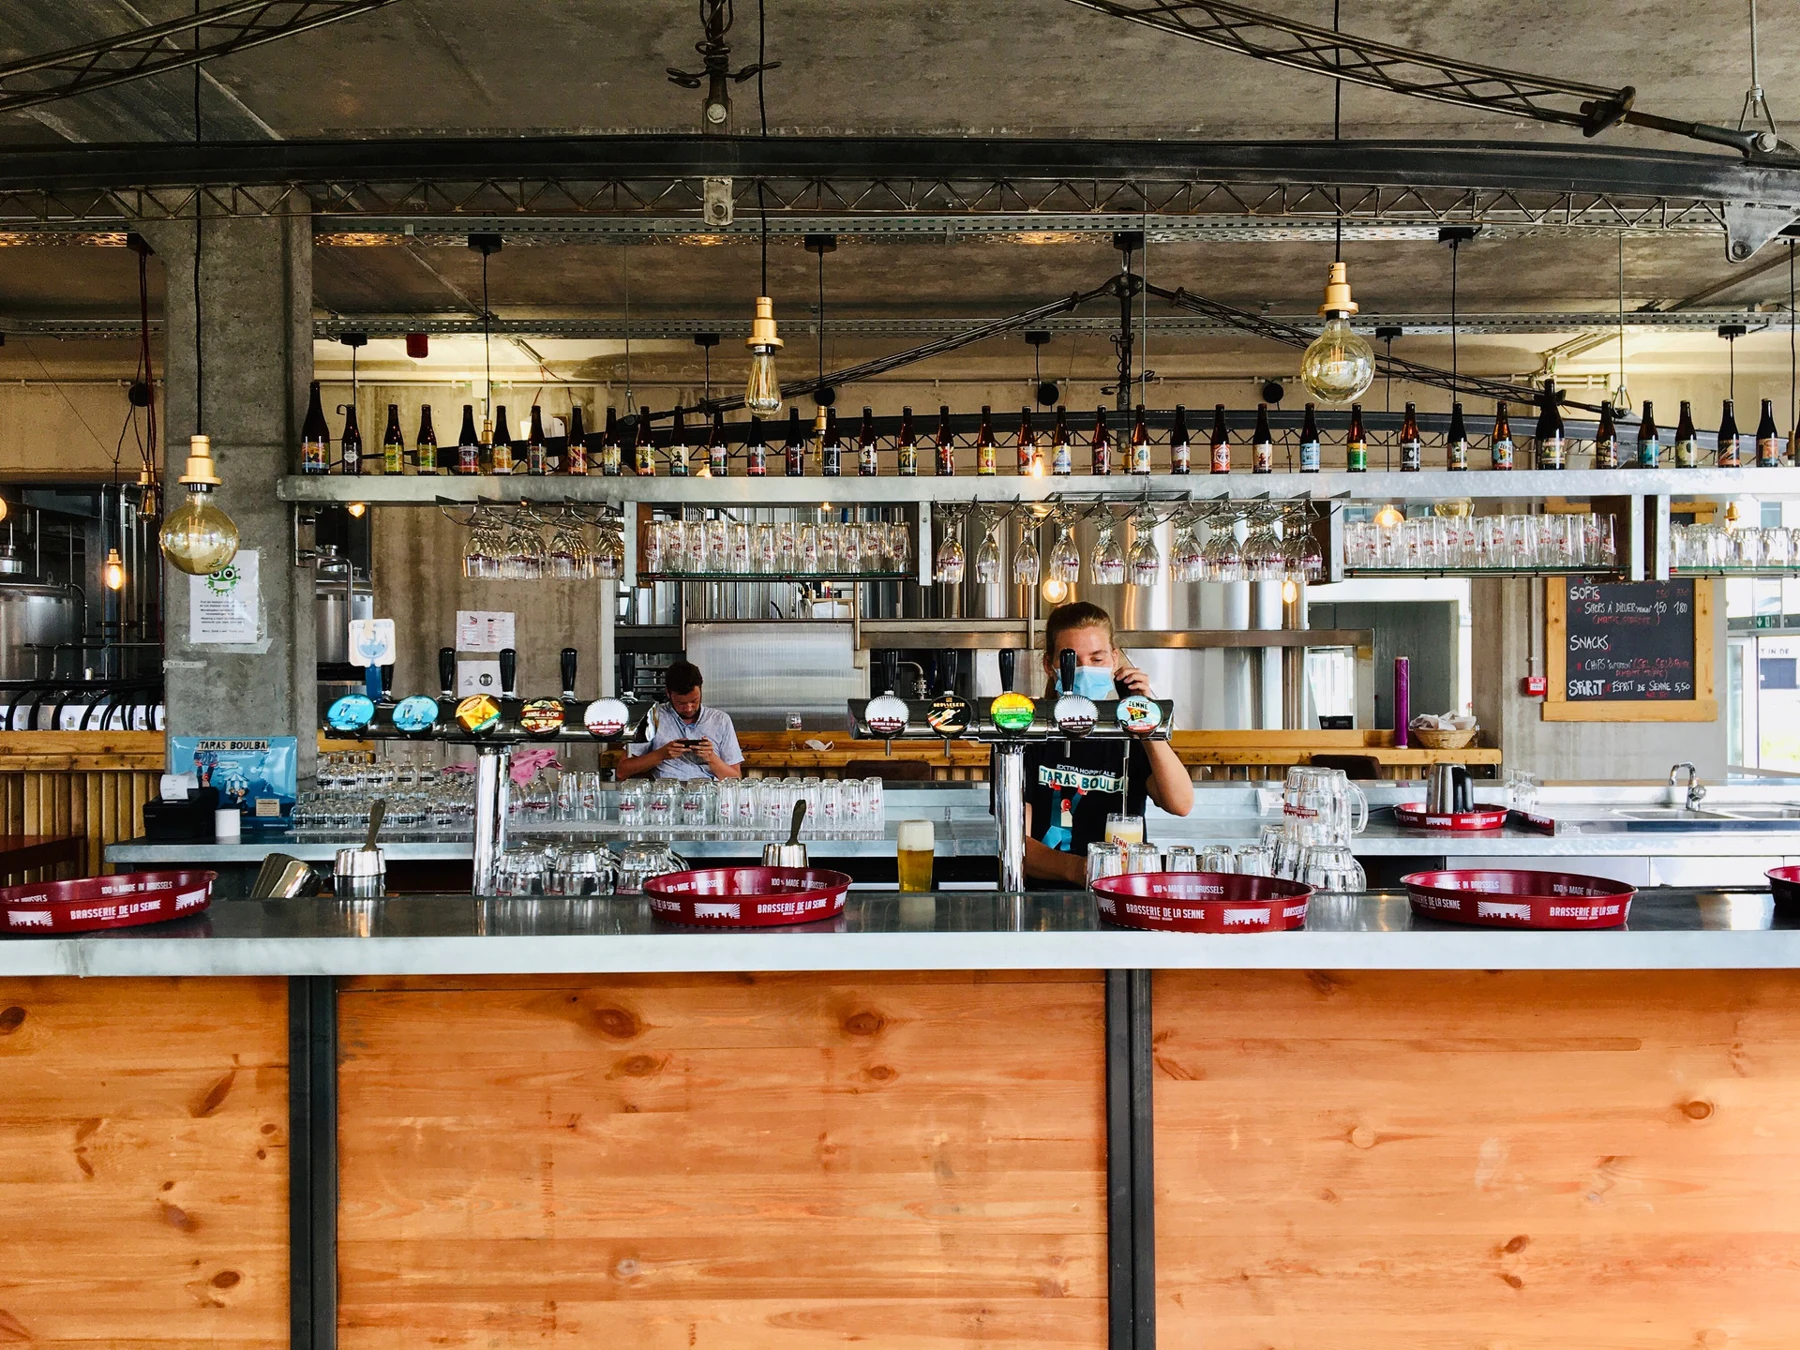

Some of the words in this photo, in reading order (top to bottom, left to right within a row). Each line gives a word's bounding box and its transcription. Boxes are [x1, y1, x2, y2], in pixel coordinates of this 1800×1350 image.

[1570, 586, 1600, 600] SOFTS
[1570, 635, 1608, 651] SNACKS
[1674, 682, 1690, 693] 5,50
[1128, 701, 1149, 710] ZENNE
[200, 741, 226, 750] TARAS
[230, 741, 266, 750] BOULBA
[1040, 768, 1077, 785] TARAS
[1057, 764, 1079, 773] EXTRA
[1080, 768, 1102, 776] HOPPY
[1112, 835, 1128, 849] ZENN
[101, 886, 112, 894] 100
[119, 883, 135, 892] MADE
[138, 883, 144, 891] IN
[146, 881, 173, 891] BRUSSELS
[771, 878, 780, 886] 100
[785, 879, 799, 887] MADE
[1462, 881, 1469, 889] IN
[1471, 880, 1499, 889] BRUSSELS
[1153, 885, 1162, 893] 100
[1168, 885, 1184, 893] MADE
[1187, 885, 1193, 893] IN
[1195, 885, 1224, 895] BRUSSELS
[1553, 884, 1563, 893] 100
[1569, 886, 1584, 895] MADE
[70, 906, 116, 920] BRASSERIE
[118, 904, 129, 915] DE
[129, 903, 139, 914] LA
[140, 900, 161, 912] SENNE
[757, 902, 795, 914] BRASSERIE
[797, 902, 804, 912] DE
[804, 901, 812, 911] LA
[812, 898, 827, 909] SENNE
[1435, 897, 1442, 907] LA
[1442, 898, 1461, 910] SENNE
[1126, 904, 1161, 917] BRASSERIE
[1163, 909, 1172, 918] DE
[1173, 909, 1182, 918] LA
[1183, 909, 1205, 920] SENNE
[1550, 906, 1590, 917] BRASSERIE
[1591, 907, 1599, 917] DE
[1599, 906, 1607, 916] LA
[1607, 904, 1620, 915] SENNE
